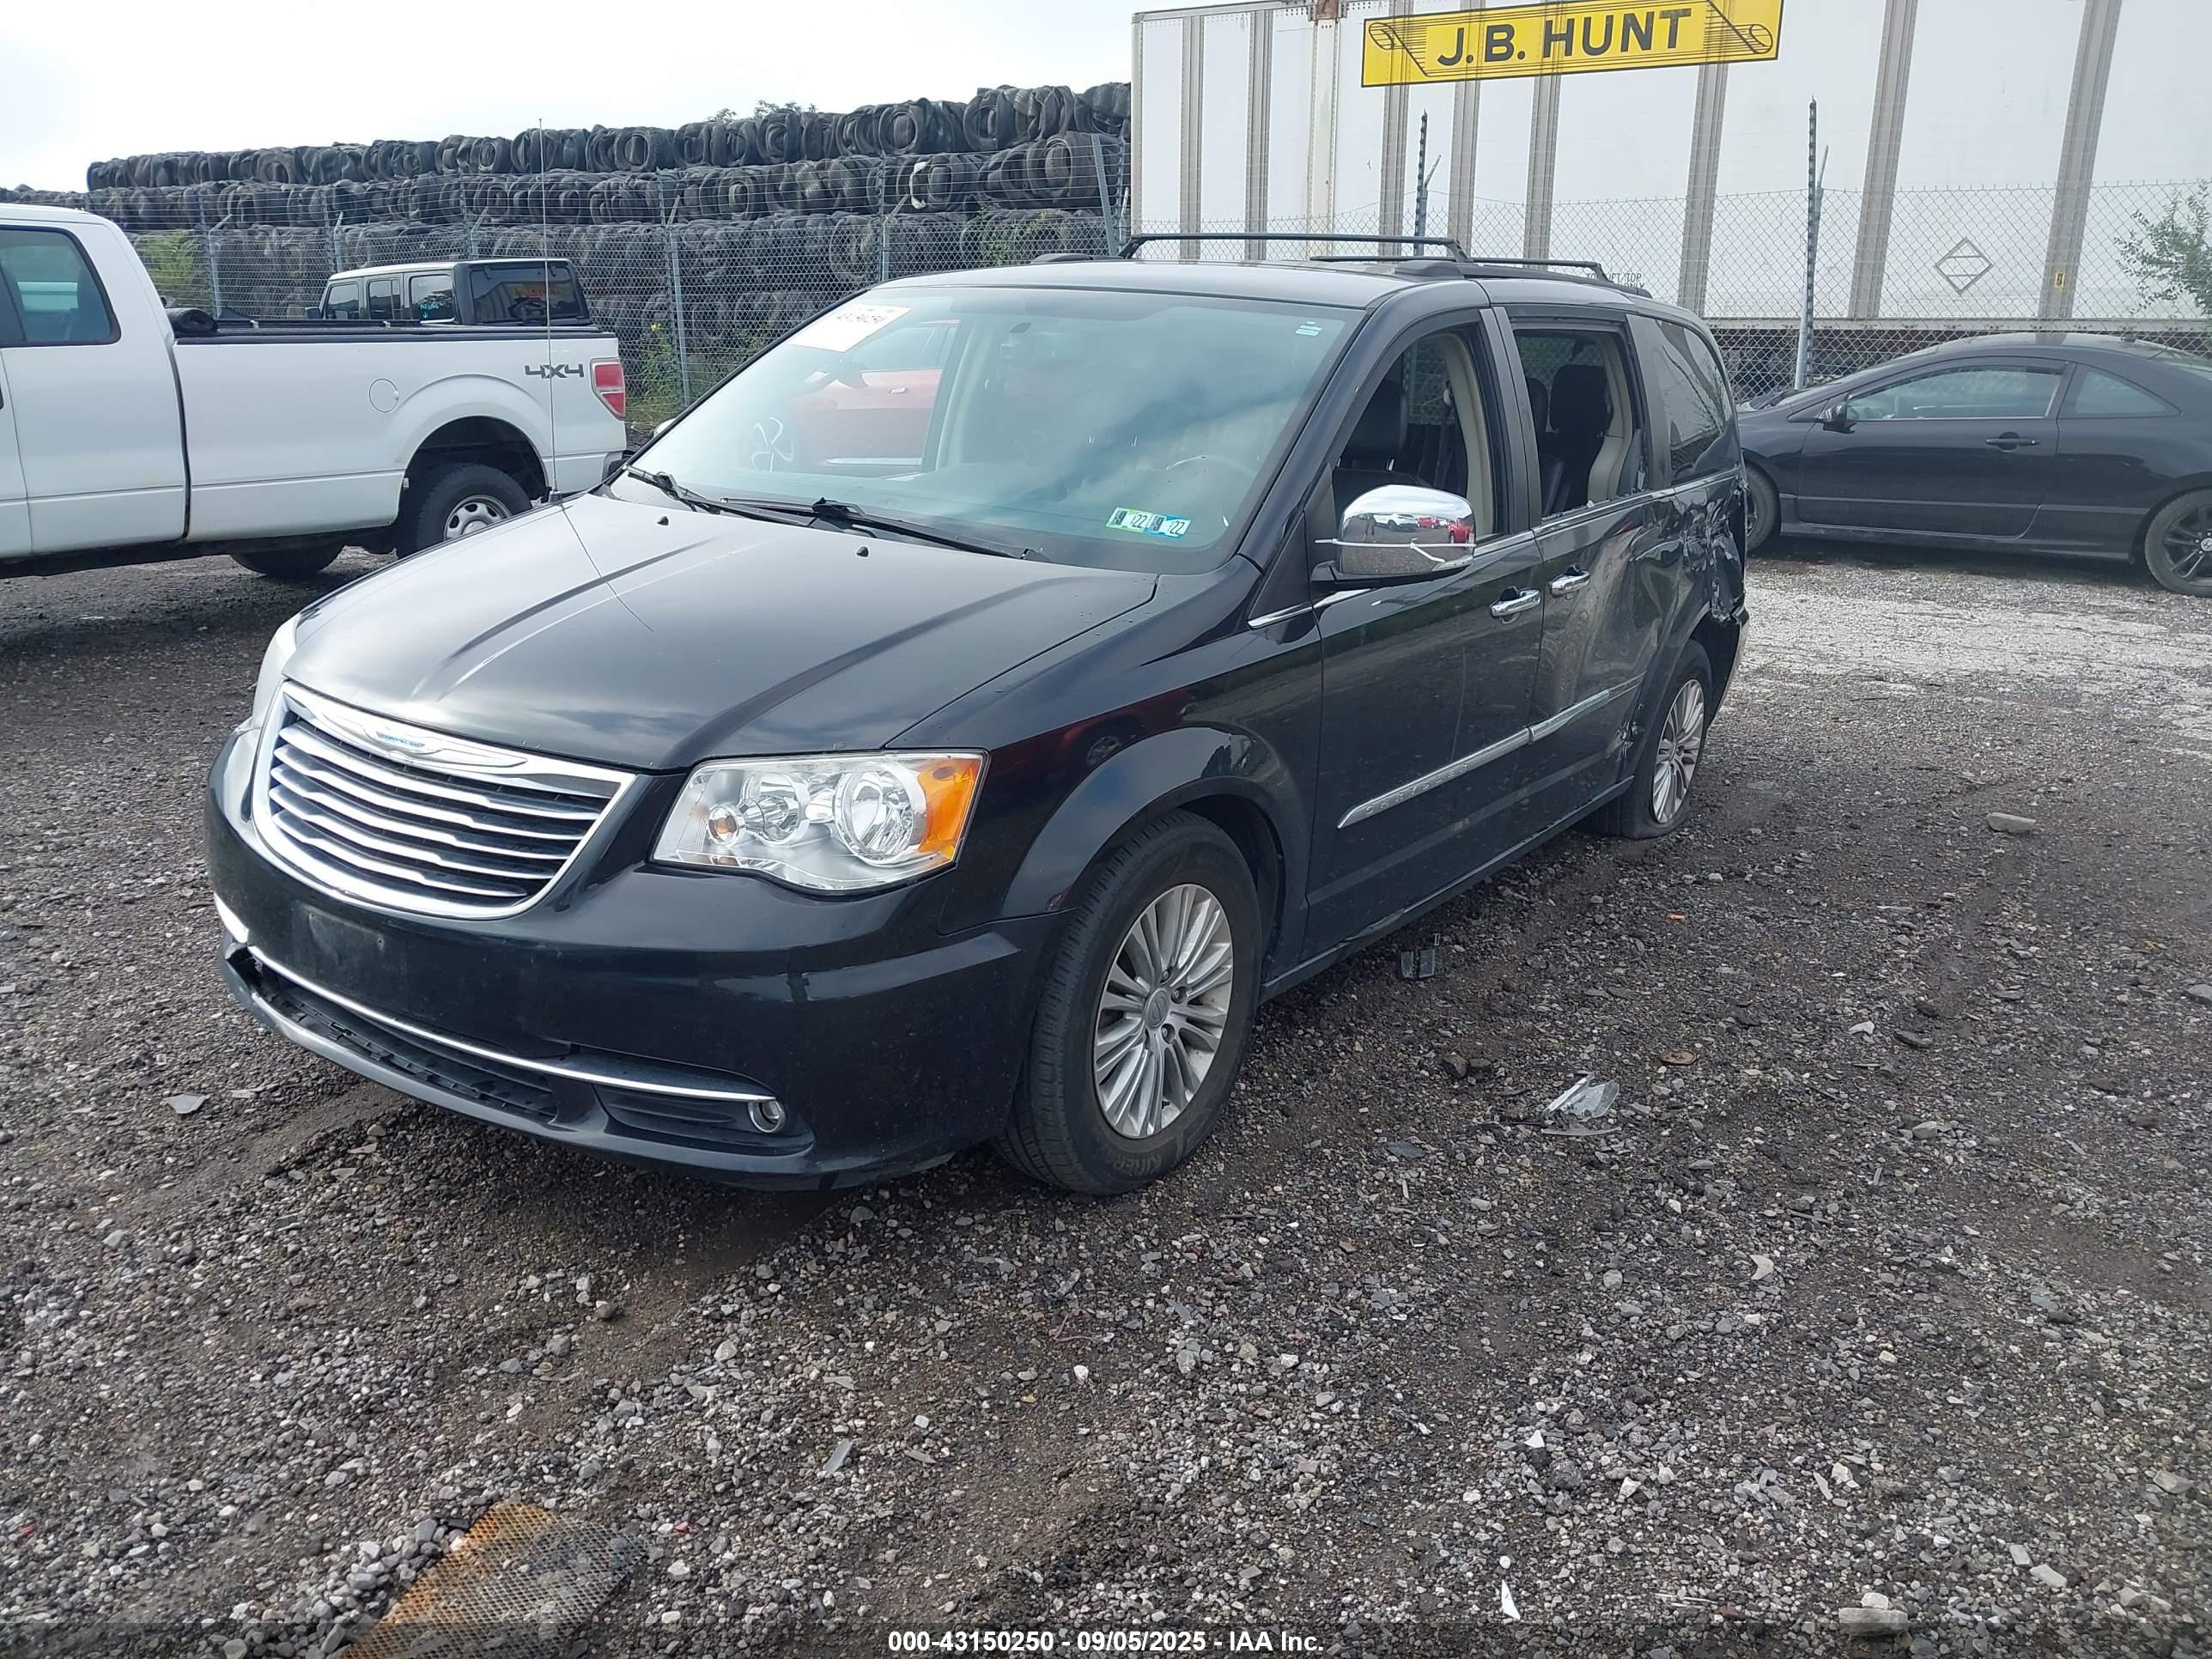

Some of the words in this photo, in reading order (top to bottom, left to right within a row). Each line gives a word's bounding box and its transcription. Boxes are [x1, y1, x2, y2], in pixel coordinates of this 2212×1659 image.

[1437, 23, 1526, 66] J.B.
[1543, 8, 1692, 58] HUNT
[1132, 514, 1148, 528] 22
[1170, 520, 1185, 534] 22
